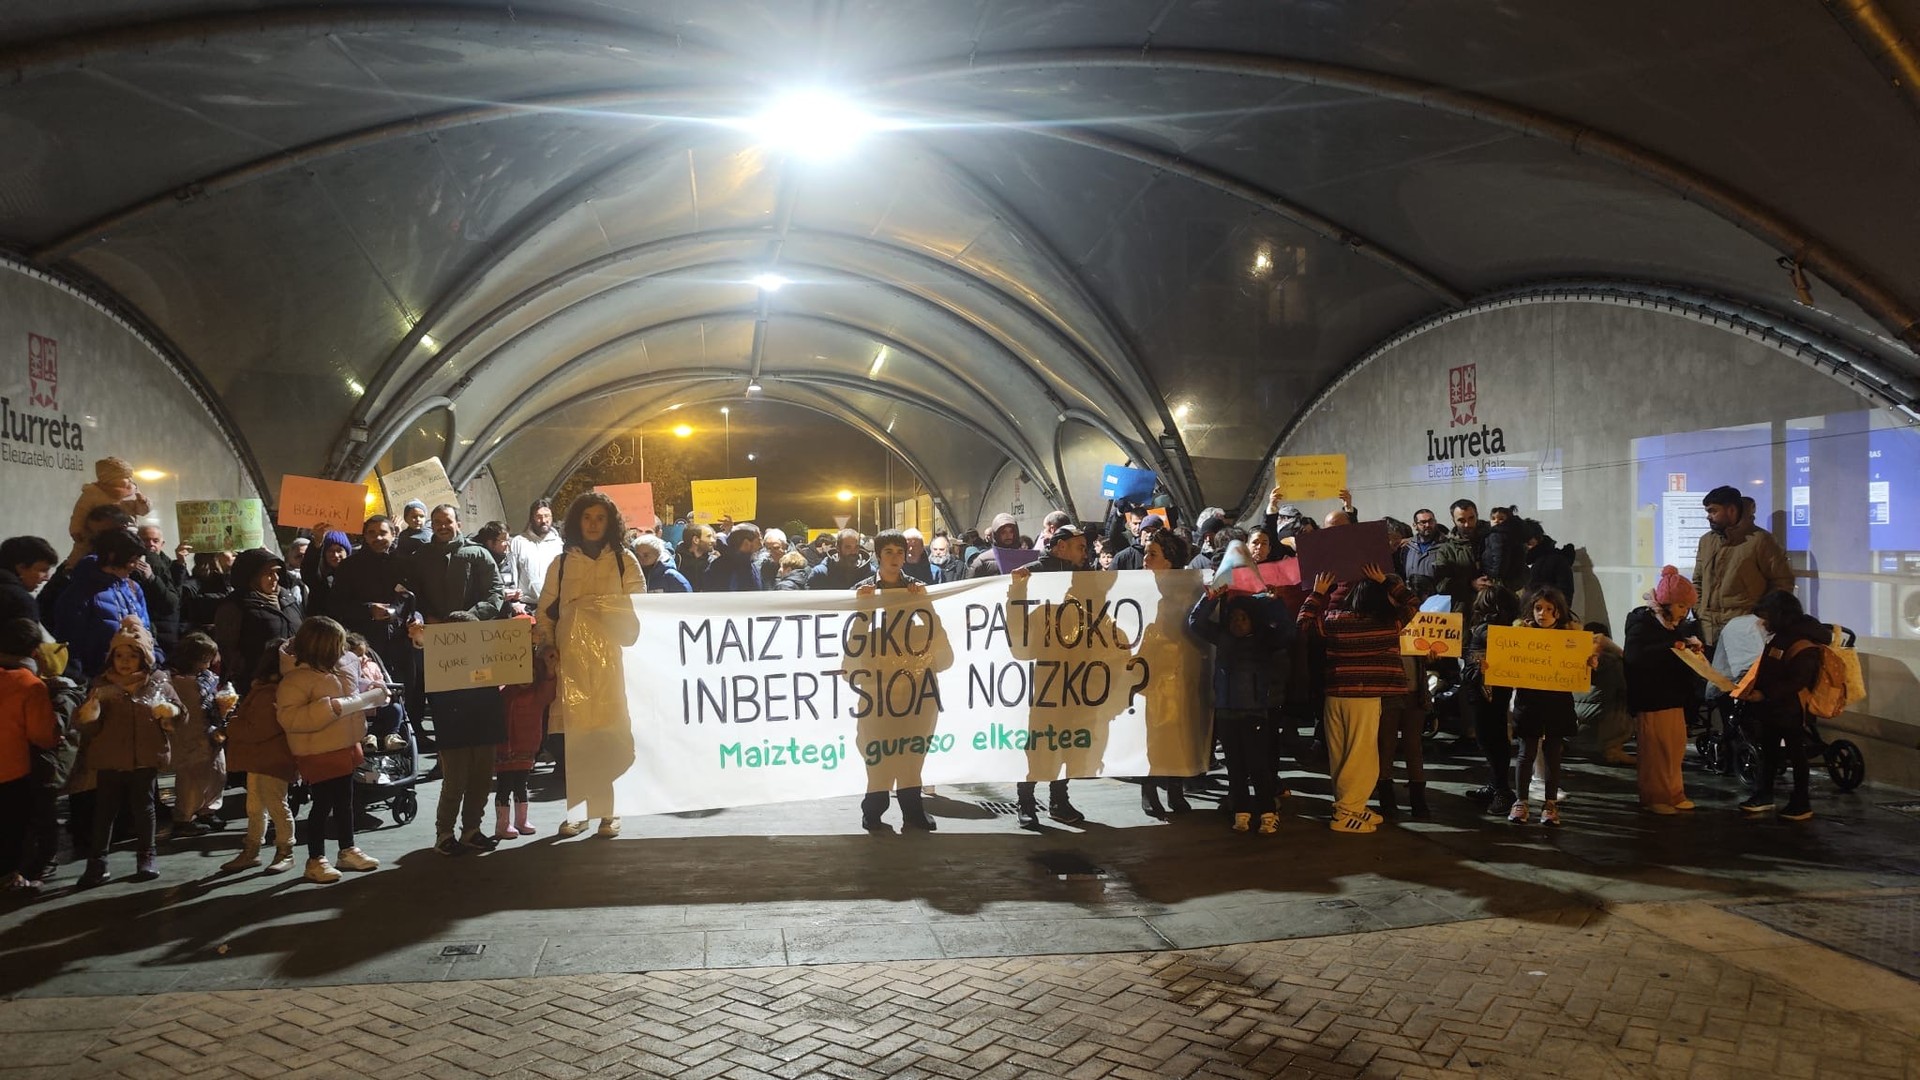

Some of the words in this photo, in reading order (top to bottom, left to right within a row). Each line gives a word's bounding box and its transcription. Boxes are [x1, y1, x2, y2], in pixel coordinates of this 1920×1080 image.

[1, 397, 83, 451] Iurreta
[1427, 424, 1505, 461] Iurreta
[1, 443, 54, 469] Eleizateko
[57, 450, 84, 471] Udala
[1428, 462, 1474, 478] Eleizateko
[1478, 459, 1506, 474] Udala
[433, 631, 466, 646] NON
[480, 629, 521, 643] DAGO
[679, 609, 934, 666] MAIZTEGIKO
[966, 598, 1144, 650] PATIOKO
[683, 668, 944, 724] INBERTSIOA
[968, 660, 1110, 709] NOIZKO
[720, 735, 845, 769] Maiztegi
[865, 733, 955, 766] guraso
[973, 723, 1091, 750] elkartea
